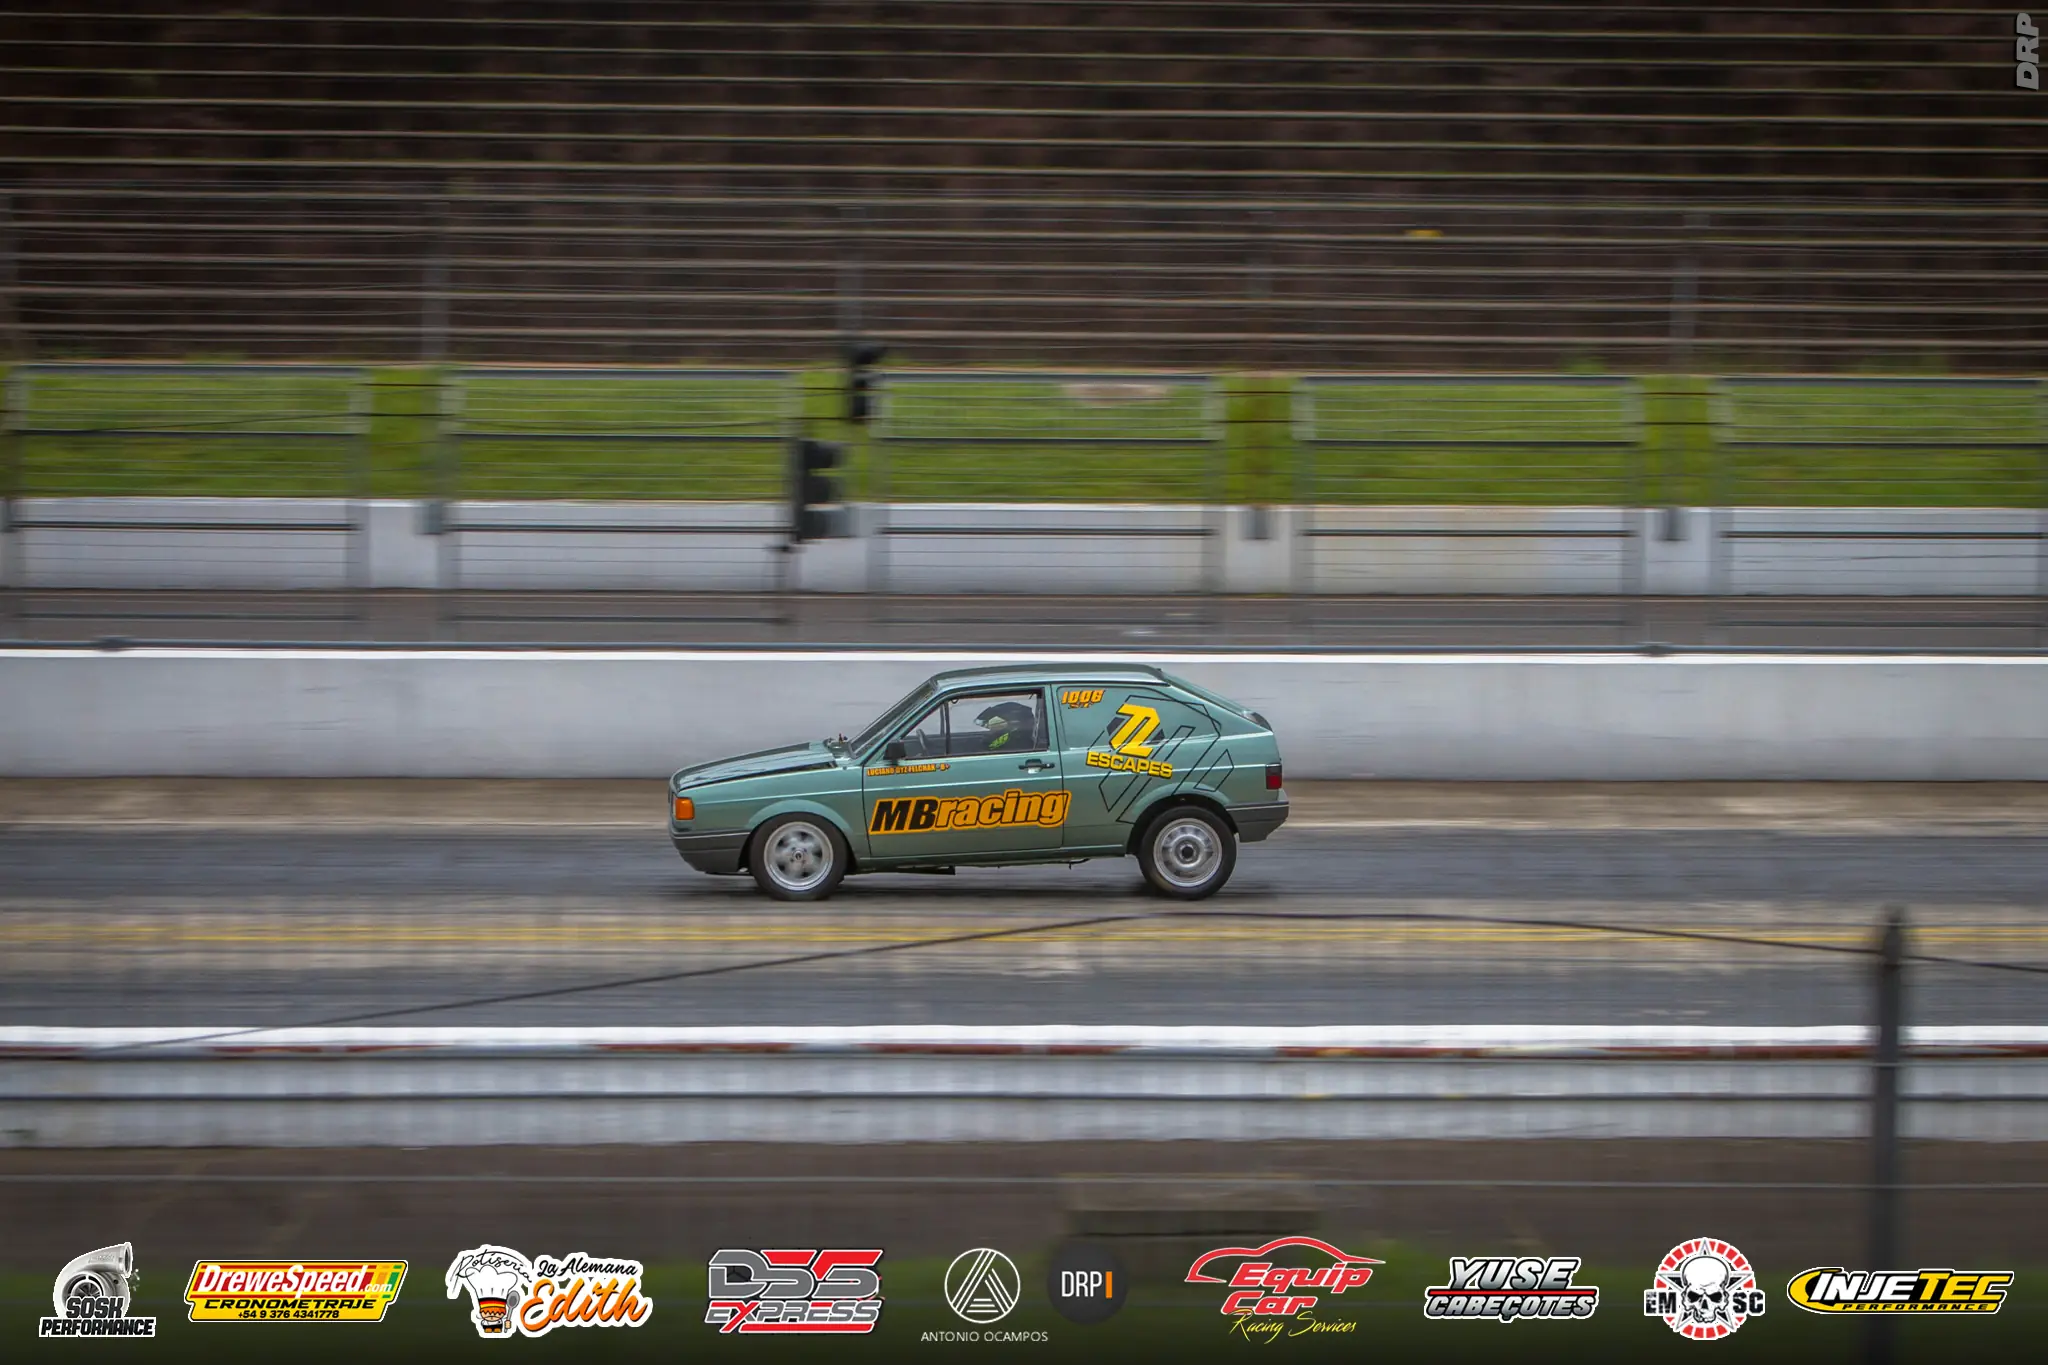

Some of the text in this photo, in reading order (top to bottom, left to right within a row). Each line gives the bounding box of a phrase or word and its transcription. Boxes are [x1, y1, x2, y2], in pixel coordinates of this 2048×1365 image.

[867, 767, 895, 776] LUCIANO
[1086, 751, 1173, 779] ESCAPES
[870, 790, 1070, 833] MBracing
